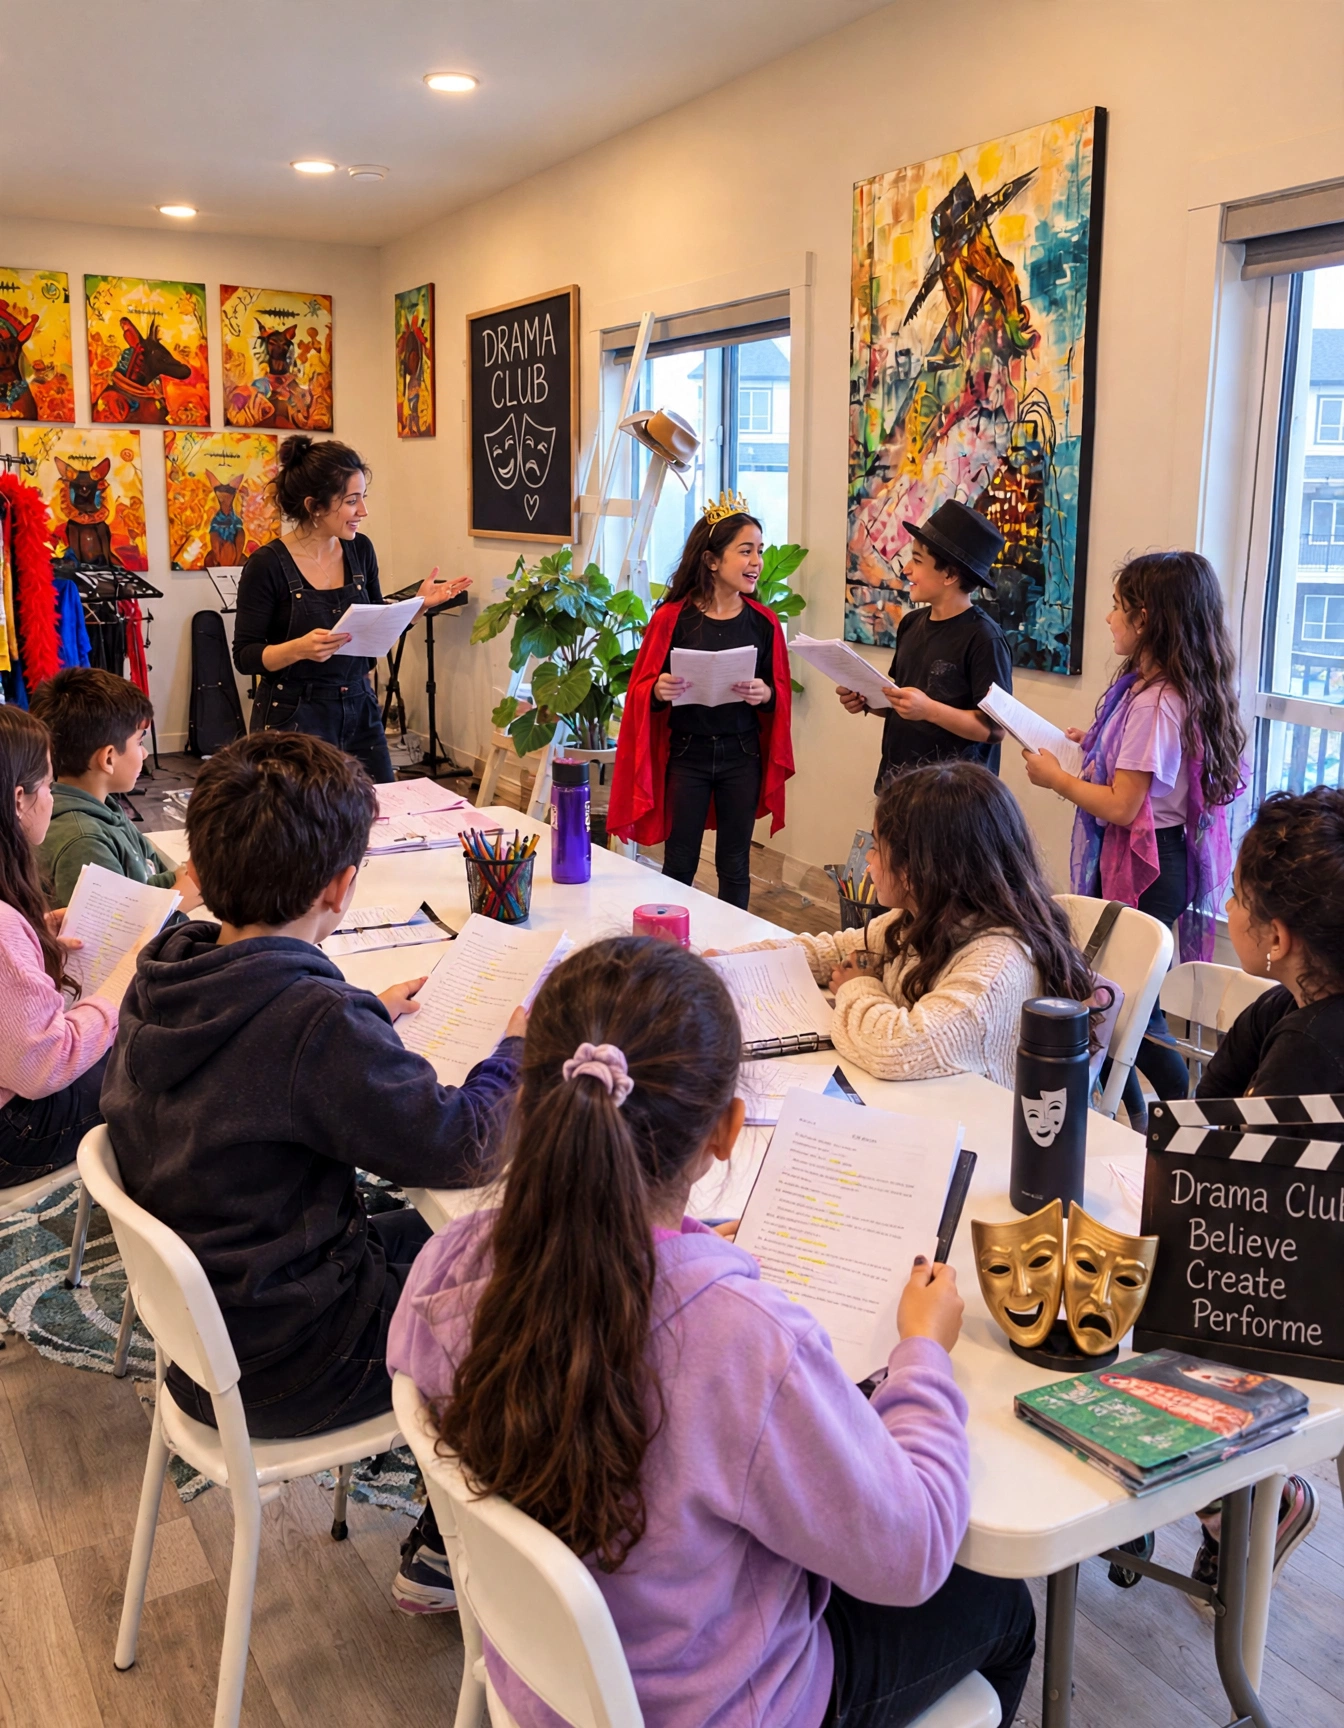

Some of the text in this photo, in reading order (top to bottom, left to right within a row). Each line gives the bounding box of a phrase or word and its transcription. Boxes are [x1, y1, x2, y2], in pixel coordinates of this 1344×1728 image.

[482, 313, 556, 367] DRAMA
[491, 363, 549, 408] CLUB
[1171, 1169, 1269, 1213] Drama
[1189, 1217, 1298, 1261] Believe
[1186, 1259, 1287, 1300] Create
[1193, 1298, 1323, 1346] Performe
